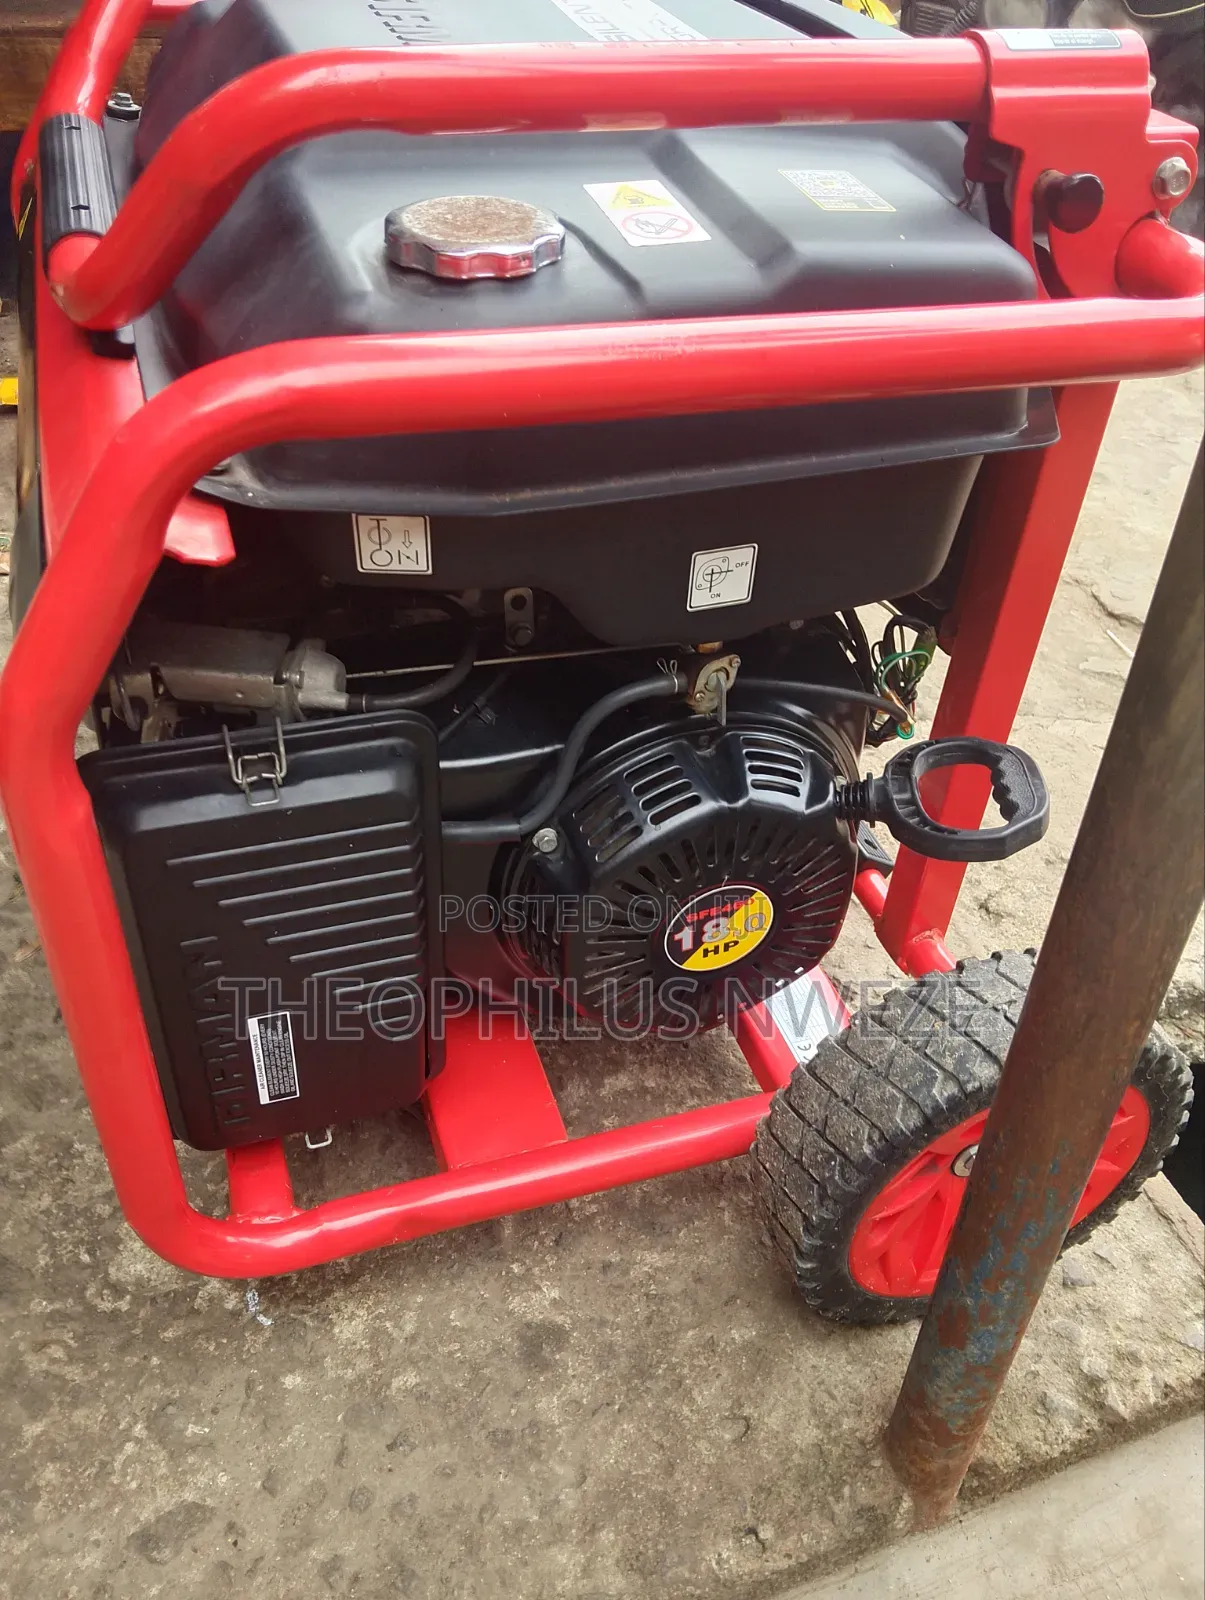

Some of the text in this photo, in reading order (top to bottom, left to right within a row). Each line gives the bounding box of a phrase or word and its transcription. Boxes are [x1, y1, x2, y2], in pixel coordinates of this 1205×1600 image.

[735, 561, 749, 569] OFF
[674, 913, 767, 952] 18.0
[702, 940, 740, 958] HP
[252, 1033, 261, 1063] MAINTENANCE
